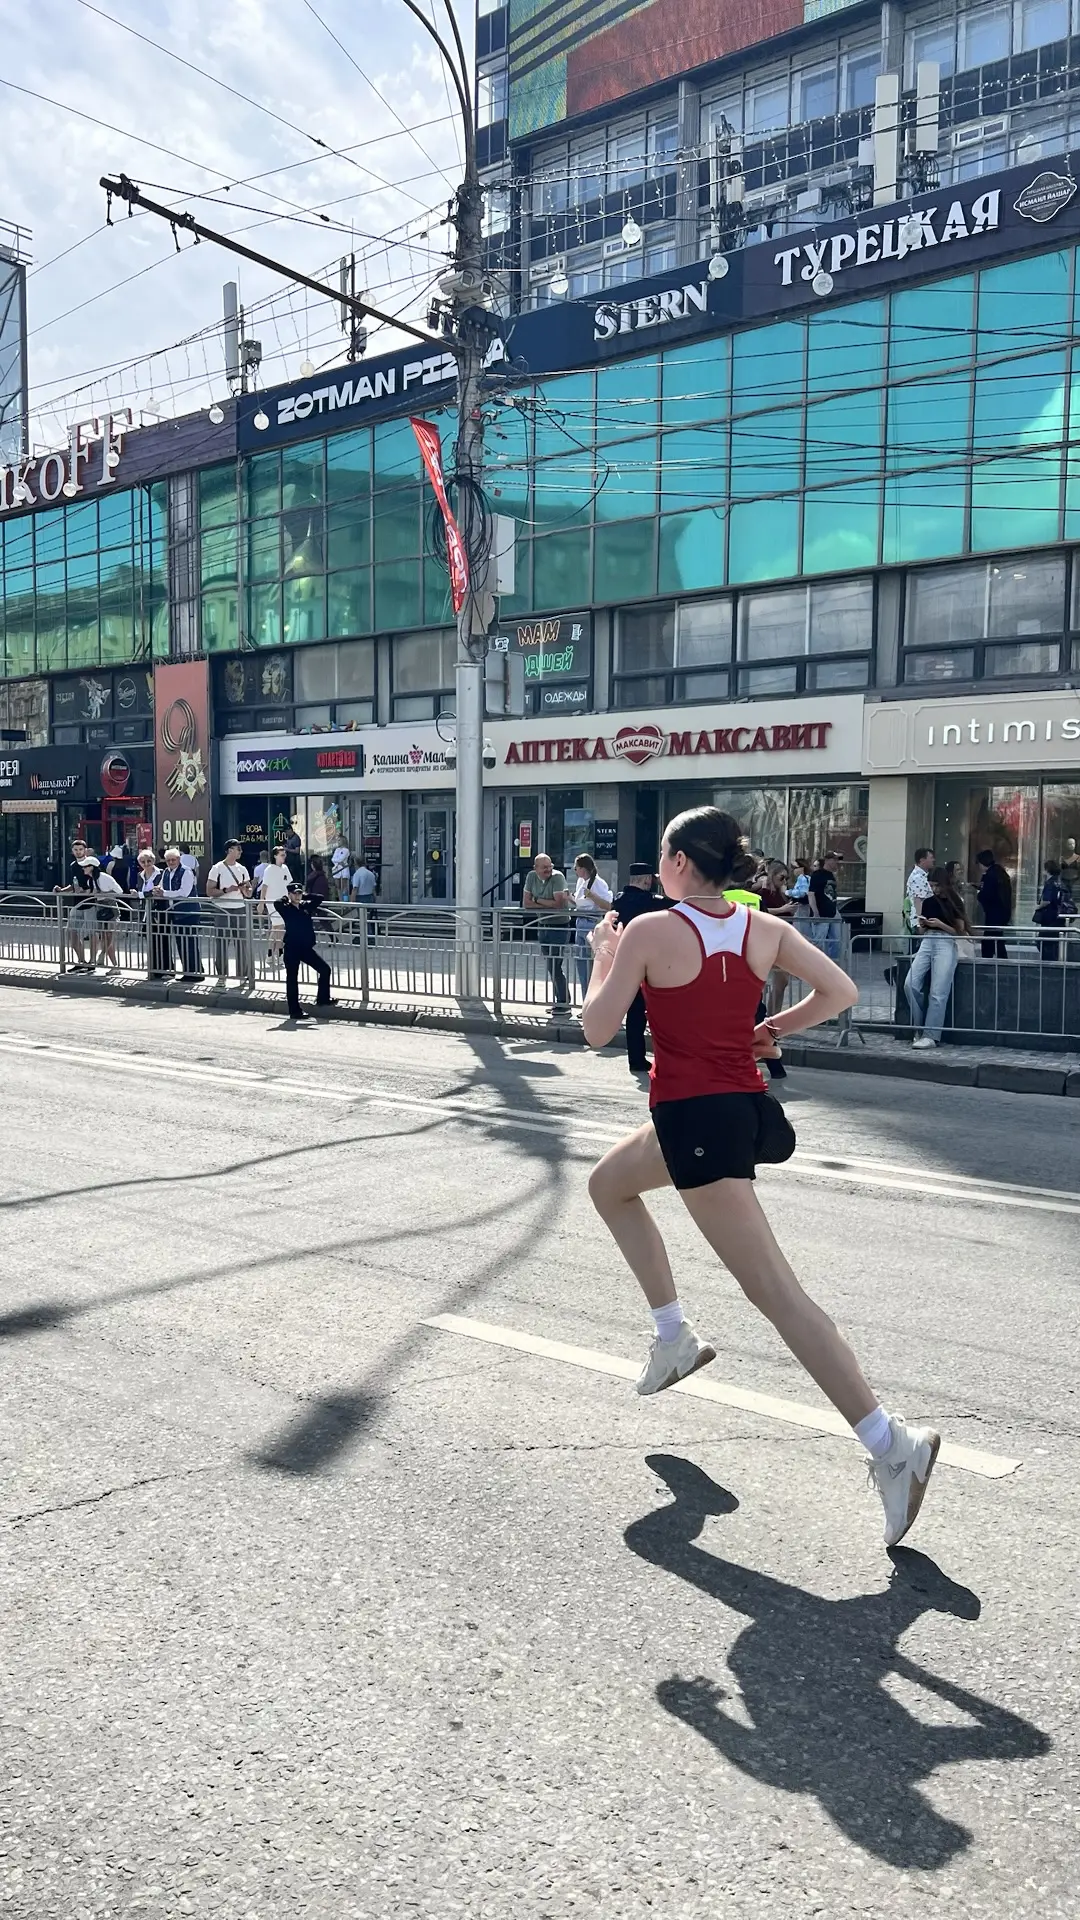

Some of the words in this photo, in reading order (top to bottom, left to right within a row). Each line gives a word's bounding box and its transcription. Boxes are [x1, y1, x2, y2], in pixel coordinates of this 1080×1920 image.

[774, 189, 1001, 285] ТУРЕЦКАЯ
[594, 281, 709, 340] STERN
[277, 368, 396, 425] ZOTMAN
[403, 338, 504, 390] PIZA
[517, 620, 560, 646] МАМ
[525, 646, 573, 677] ДШЕЙ
[544, 691, 587, 703] ОДЕЖДЫ
[504, 737, 609, 764] АПТЕКА
[615, 739, 660, 752] МАКСАВИТ
[667, 723, 832, 756] МАКСАВИТ
[163, 820, 172, 843] 9
[175, 820, 204, 842] МАЯ
